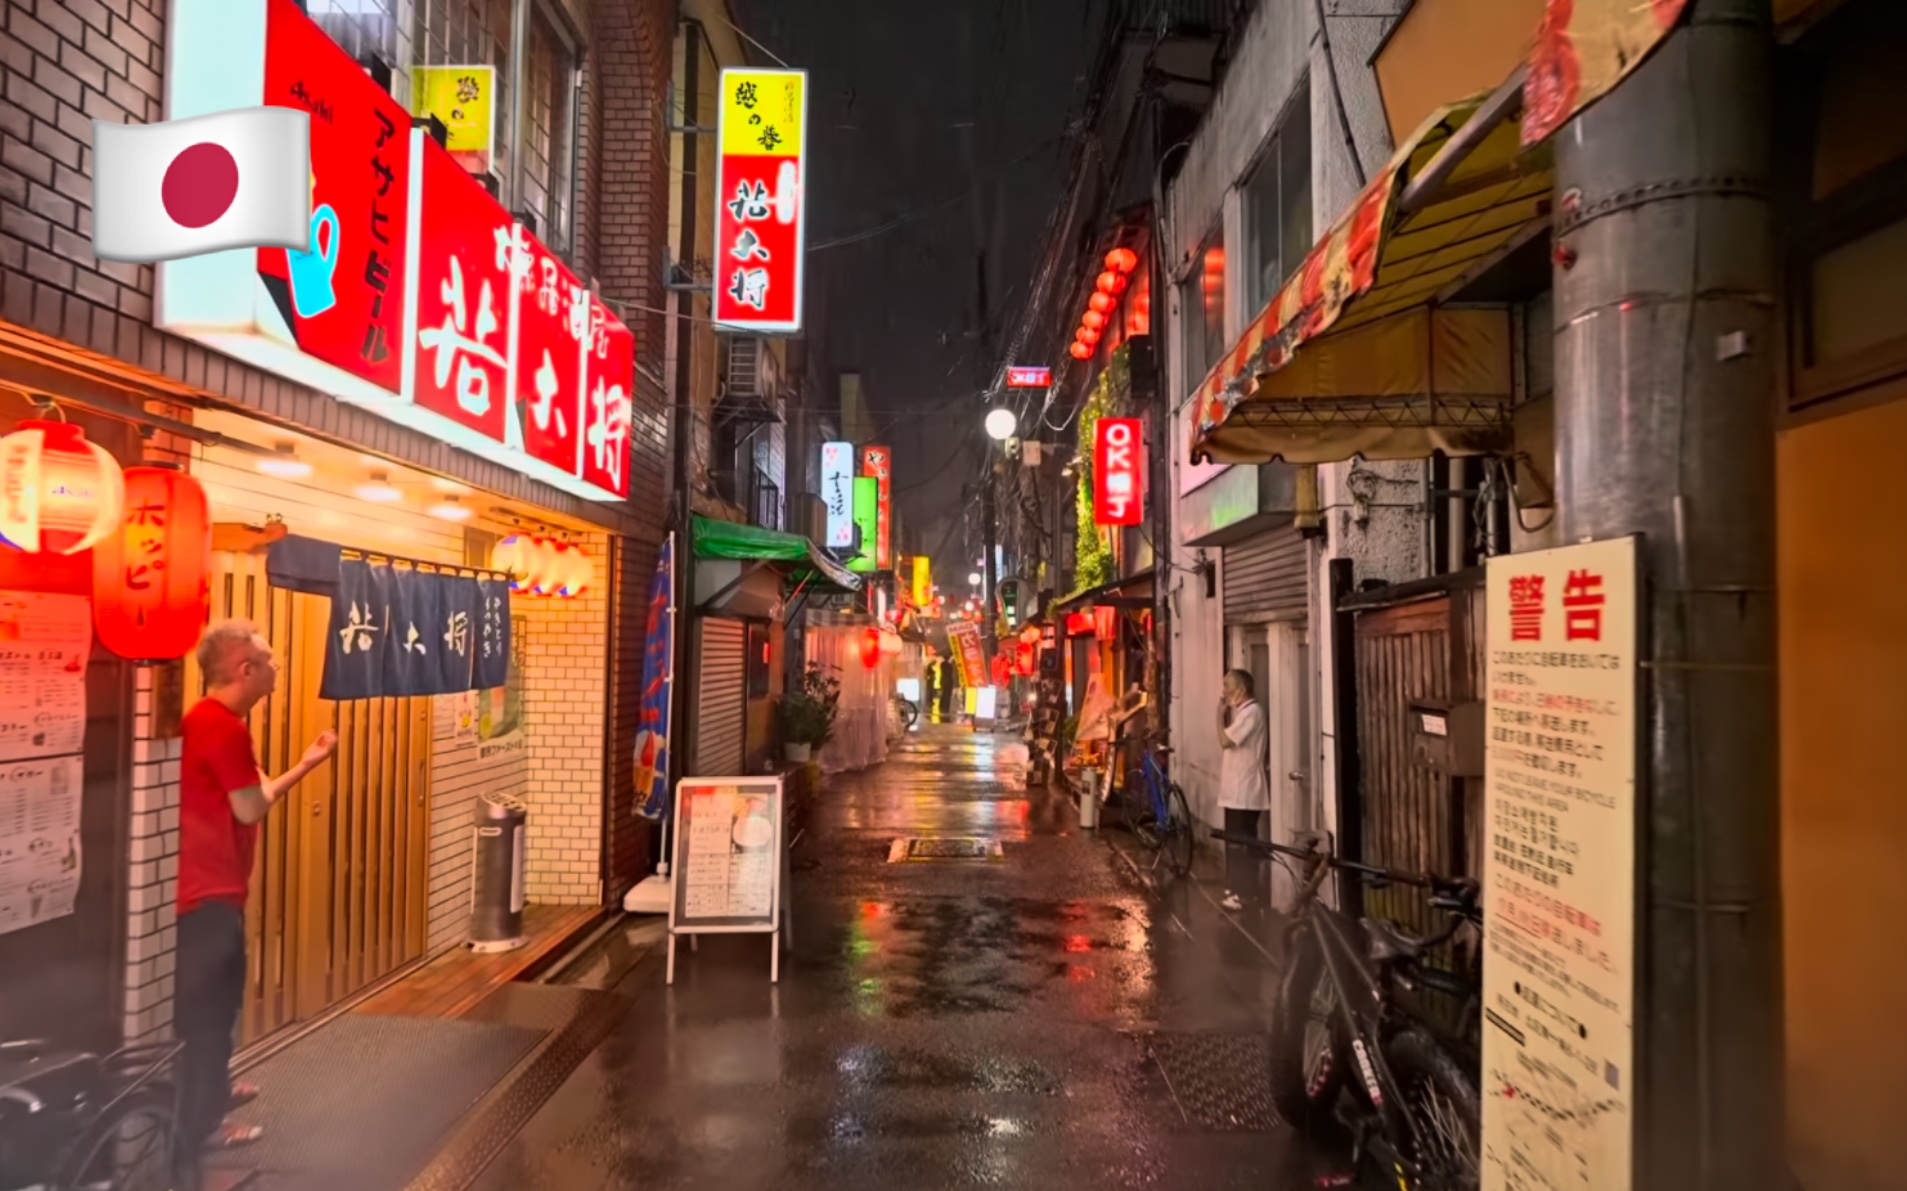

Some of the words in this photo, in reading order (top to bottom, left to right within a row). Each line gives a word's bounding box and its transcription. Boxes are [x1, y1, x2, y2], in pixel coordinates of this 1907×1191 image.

[360, 108, 395, 362] アサヒビール
[127, 498, 165, 627] ホッピー
[1508, 568, 1605, 642] 警告
[1575, 786, 1617, 809] BICYCLE
